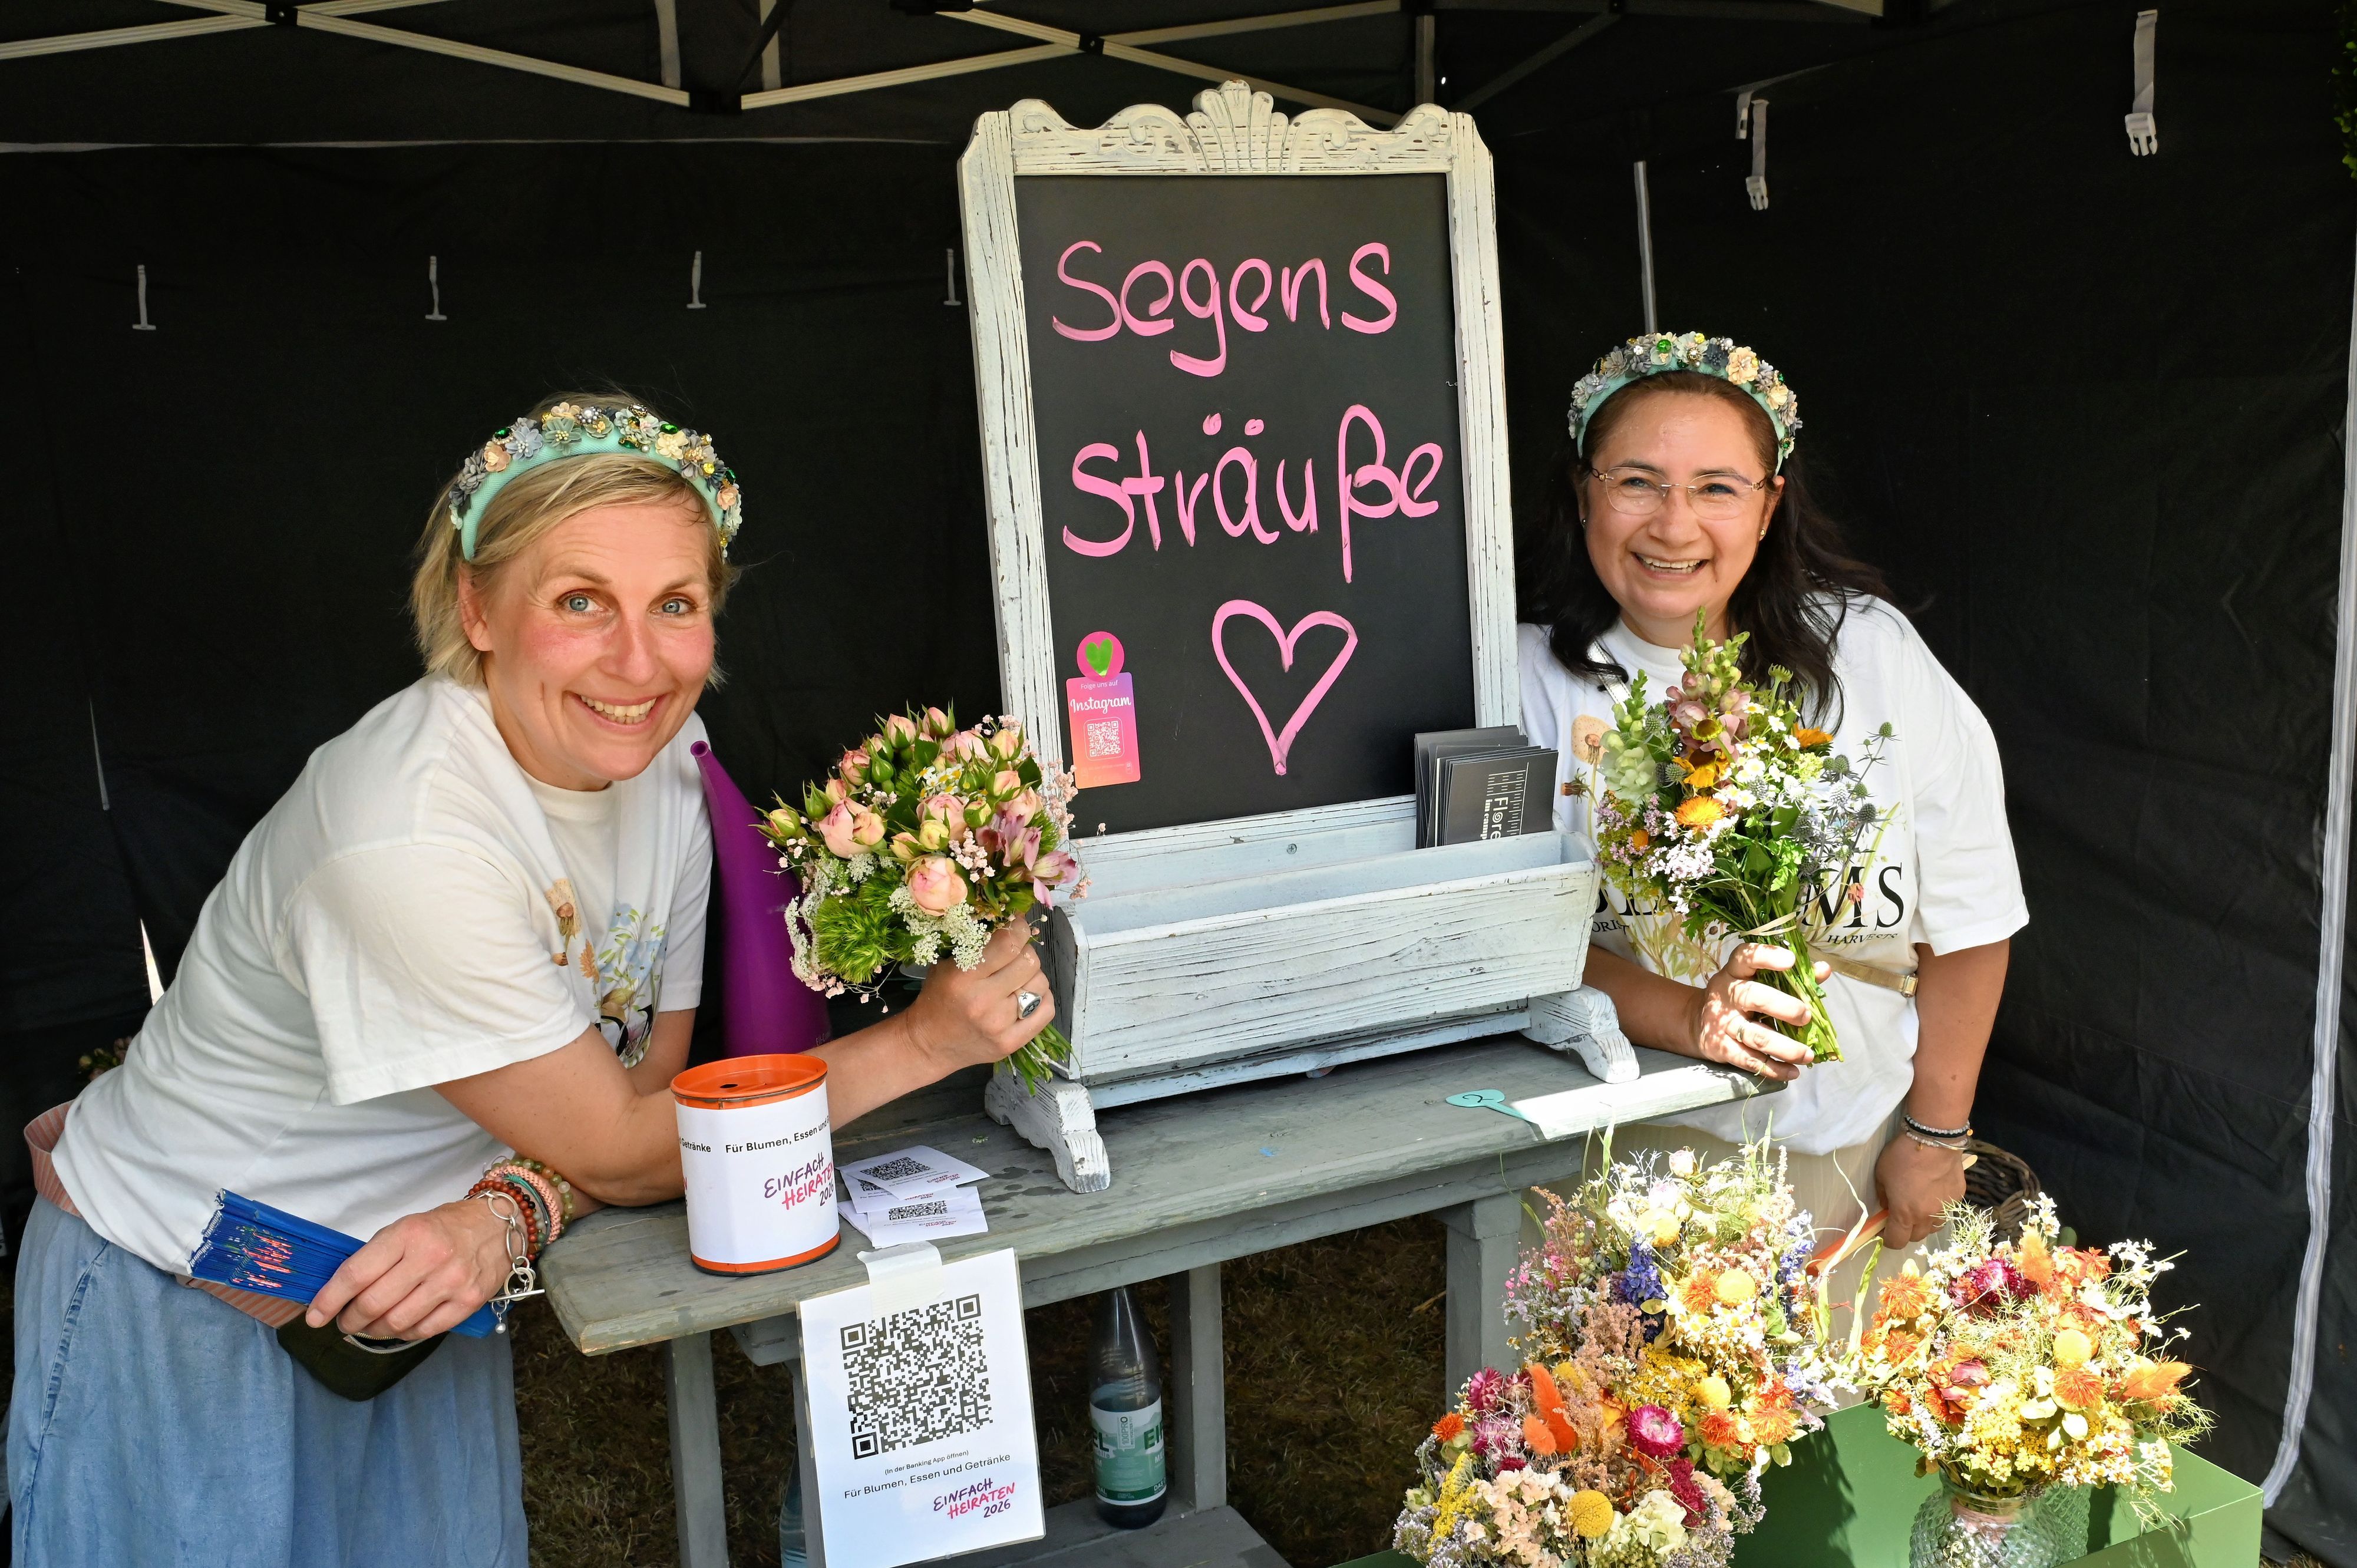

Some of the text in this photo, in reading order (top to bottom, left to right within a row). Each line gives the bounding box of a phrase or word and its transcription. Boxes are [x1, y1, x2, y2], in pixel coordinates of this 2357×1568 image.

[1052, 240, 1397, 377] Segens
[1062, 404, 1443, 583] Sträuße
[1069, 696, 1131, 714] Instagram
[681, 1138, 711, 1152] Getränke
[725, 1144, 743, 1153] Für
[746, 1138, 791, 1151] Blumen,
[794, 1127, 817, 1142] Essen
[764, 1151, 824, 1199] EINFACH
[844, 1454, 1011, 1498] Für Blumen, Essen und Getränke
[906, 1459, 932, 1470] Banking
[946, 1450, 969, 1460] öffnen)
[933, 1477, 993, 1511] EINFACH
[947, 1482, 1015, 1519] HEIRATEN
[983, 1498, 1011, 1518] 2026
